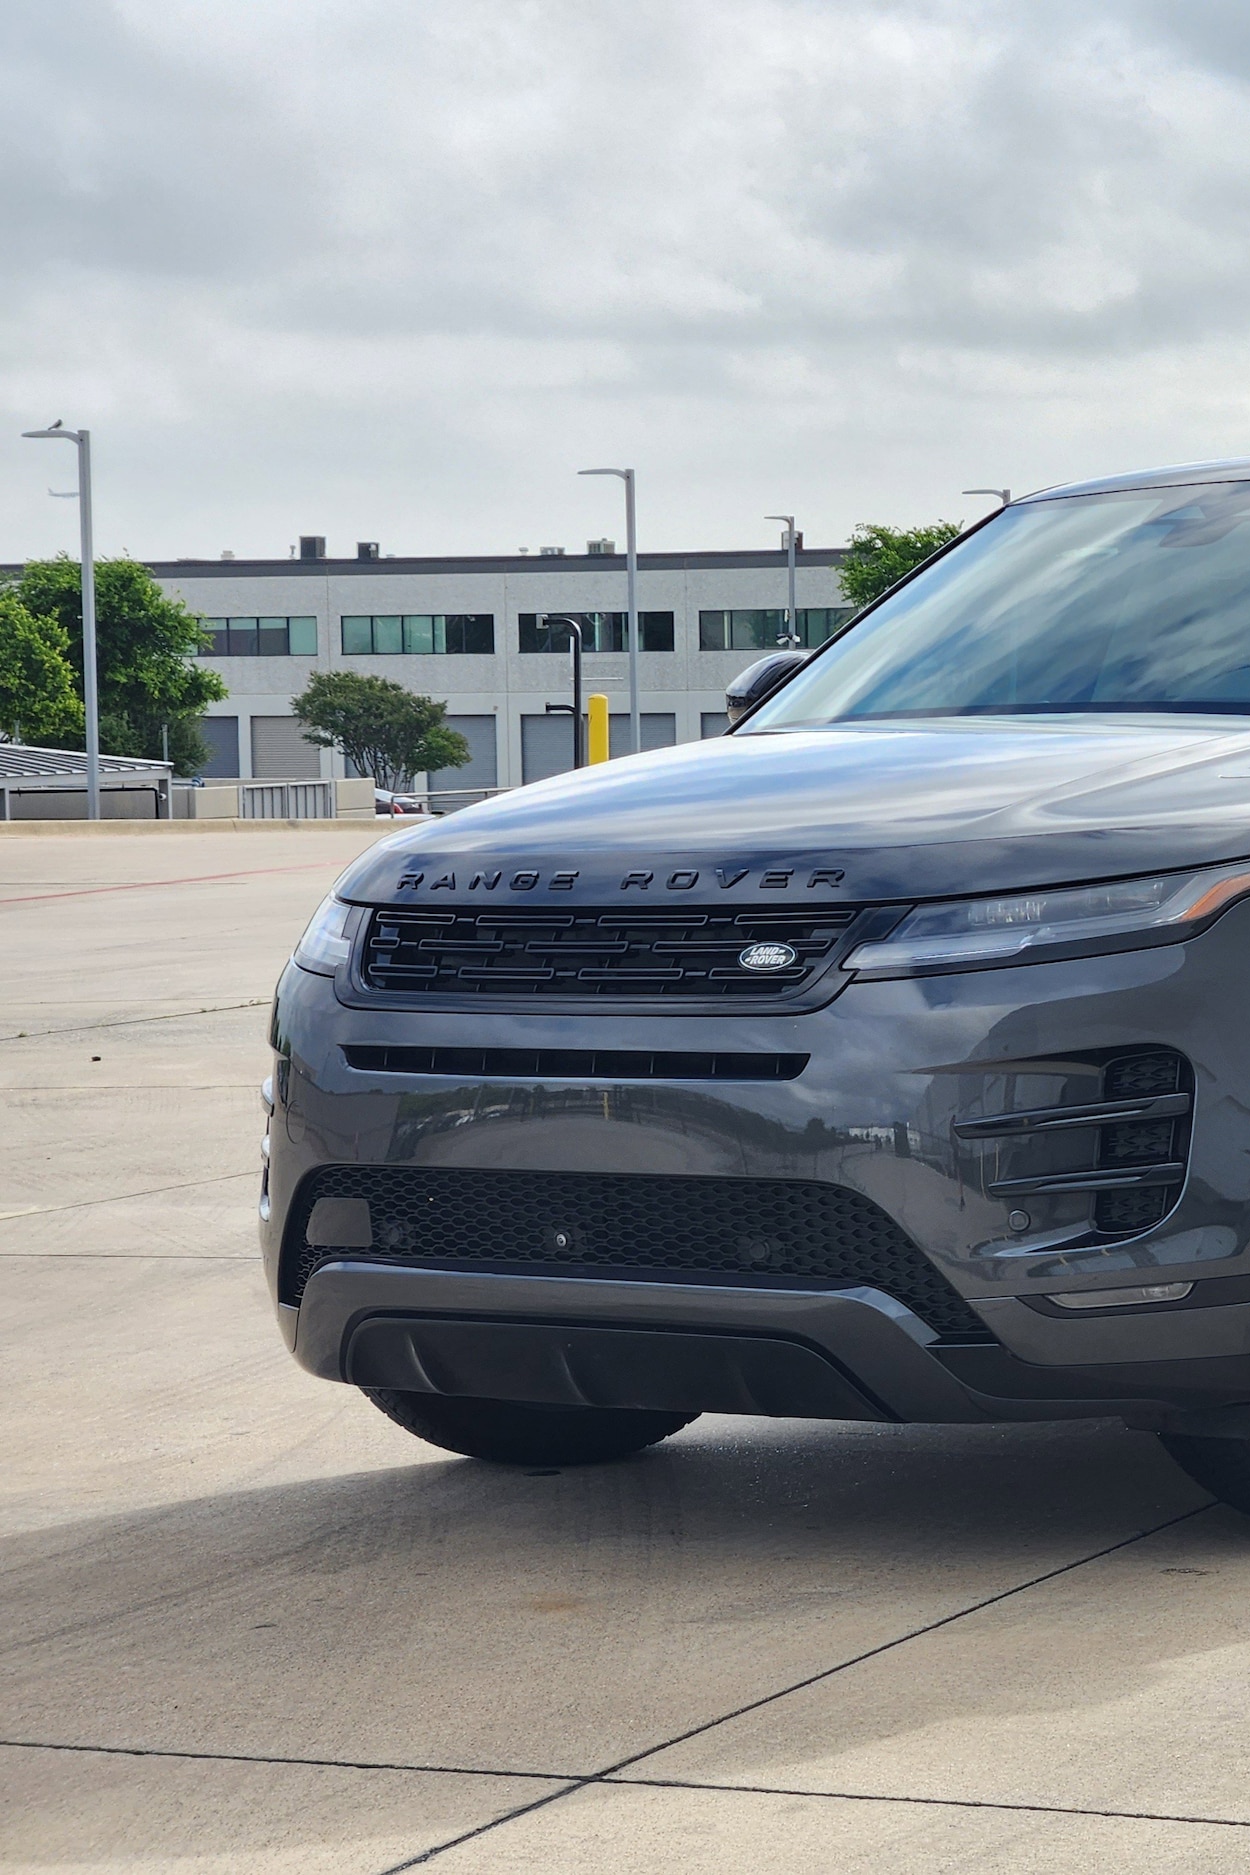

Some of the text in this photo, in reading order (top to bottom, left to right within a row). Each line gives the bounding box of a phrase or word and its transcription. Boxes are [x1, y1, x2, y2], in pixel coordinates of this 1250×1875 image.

[396, 867, 846, 891] RANGE ROVER
[750, 946, 780, 956] LAND
[749, 955, 786, 965] ROVER
